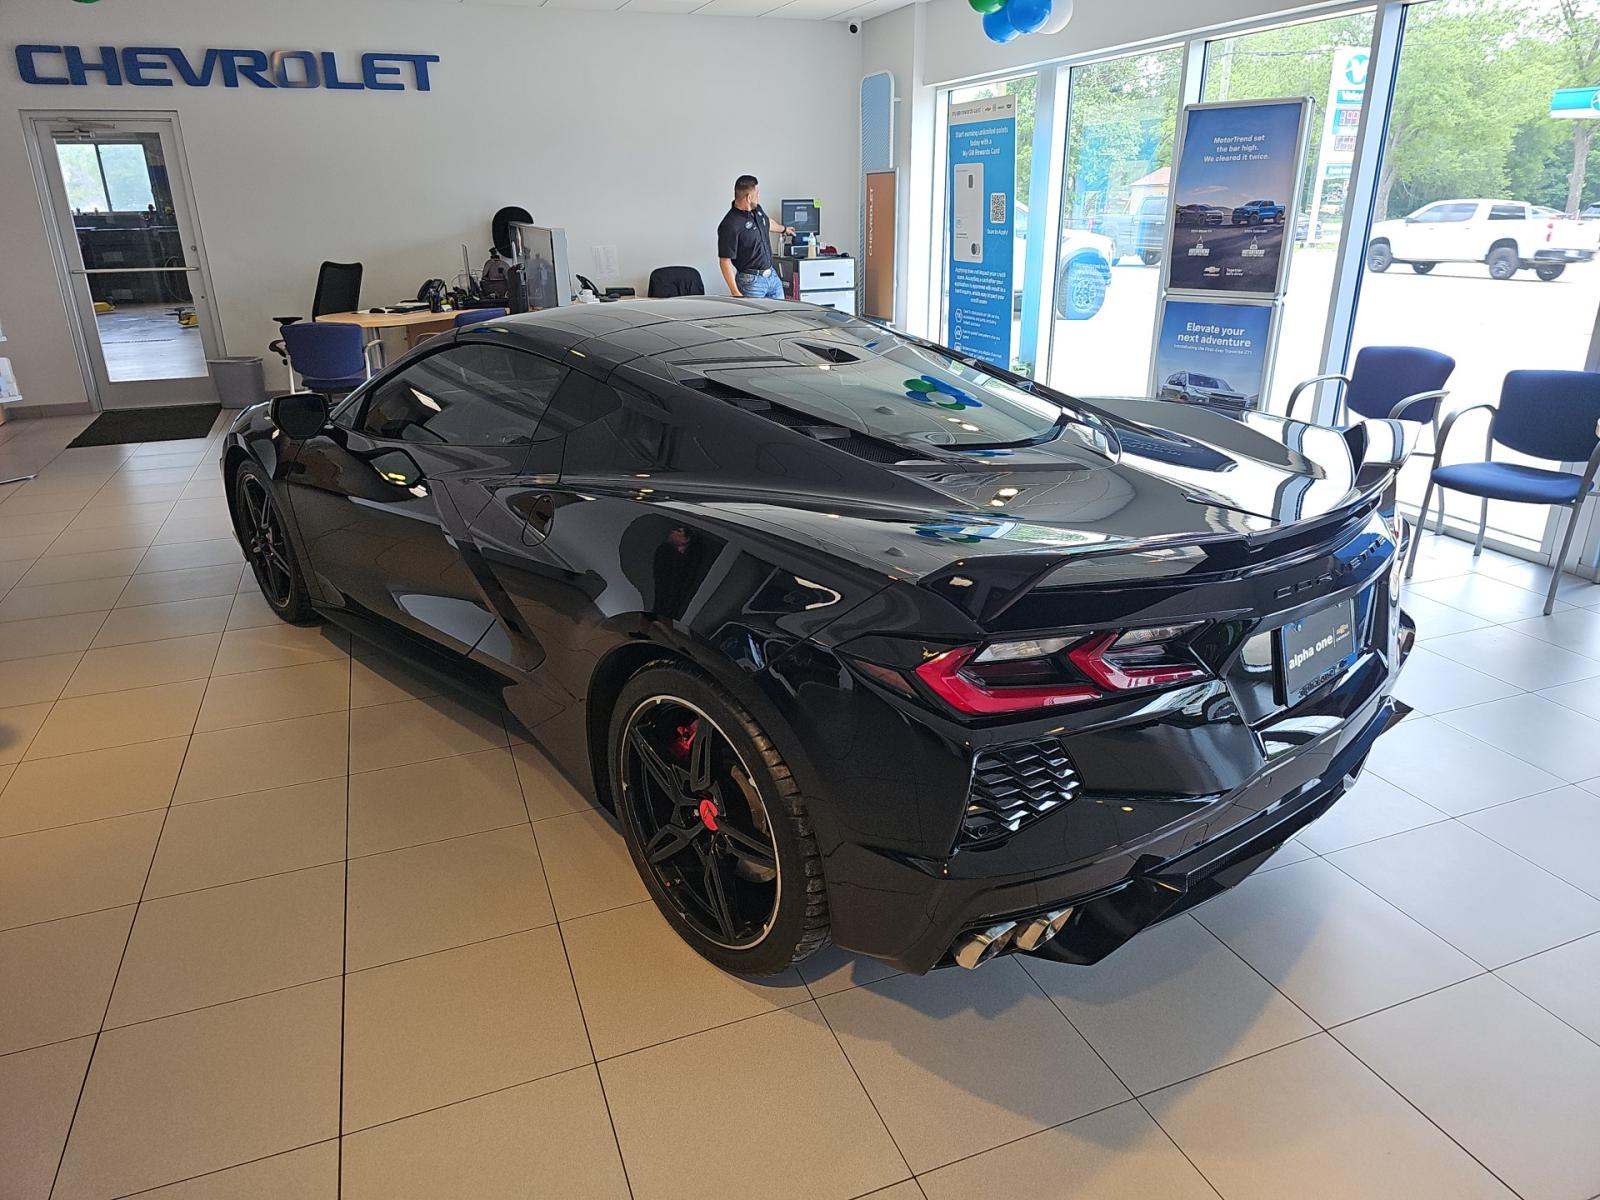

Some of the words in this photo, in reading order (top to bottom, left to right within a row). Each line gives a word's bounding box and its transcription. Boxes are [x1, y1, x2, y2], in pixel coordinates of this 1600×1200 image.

[15, 44, 440, 91] CHEVROLET
[1213, 135, 1252, 144] MotorTrend
[1253, 134, 1266, 142] set
[1216, 145, 1228, 153] the
[1215, 153, 1241, 162] cleared
[1186, 322, 1220, 334] Elevate
[1221, 327, 1245, 336] your
[1177, 333, 1200, 343] next
[1200, 335, 1251, 347] adventure
[1288, 645, 1314, 670] alpha
[1315, 633, 1333, 652] one
